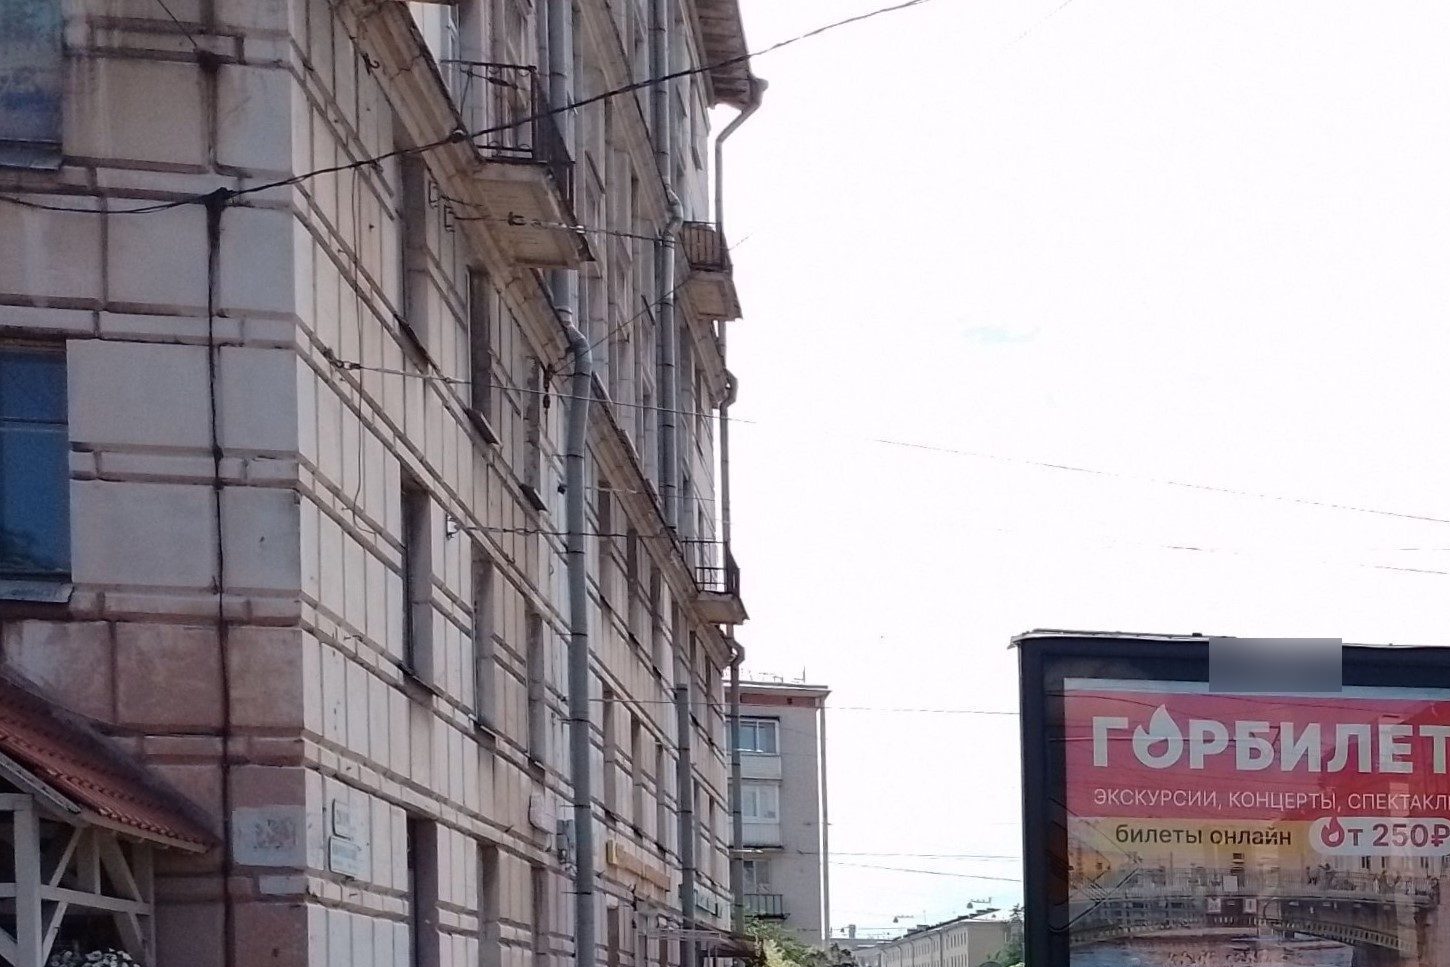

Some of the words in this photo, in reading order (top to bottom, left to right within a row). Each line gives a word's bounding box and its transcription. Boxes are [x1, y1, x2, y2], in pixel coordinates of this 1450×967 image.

[1094, 788, 1223, 810] ЭКСКУРСИИ,
[1229, 791, 1342, 812] КОНЦЕРТЫ,
[1115, 824, 1202, 844] билеты
[1210, 827, 1291, 846] онлайн
